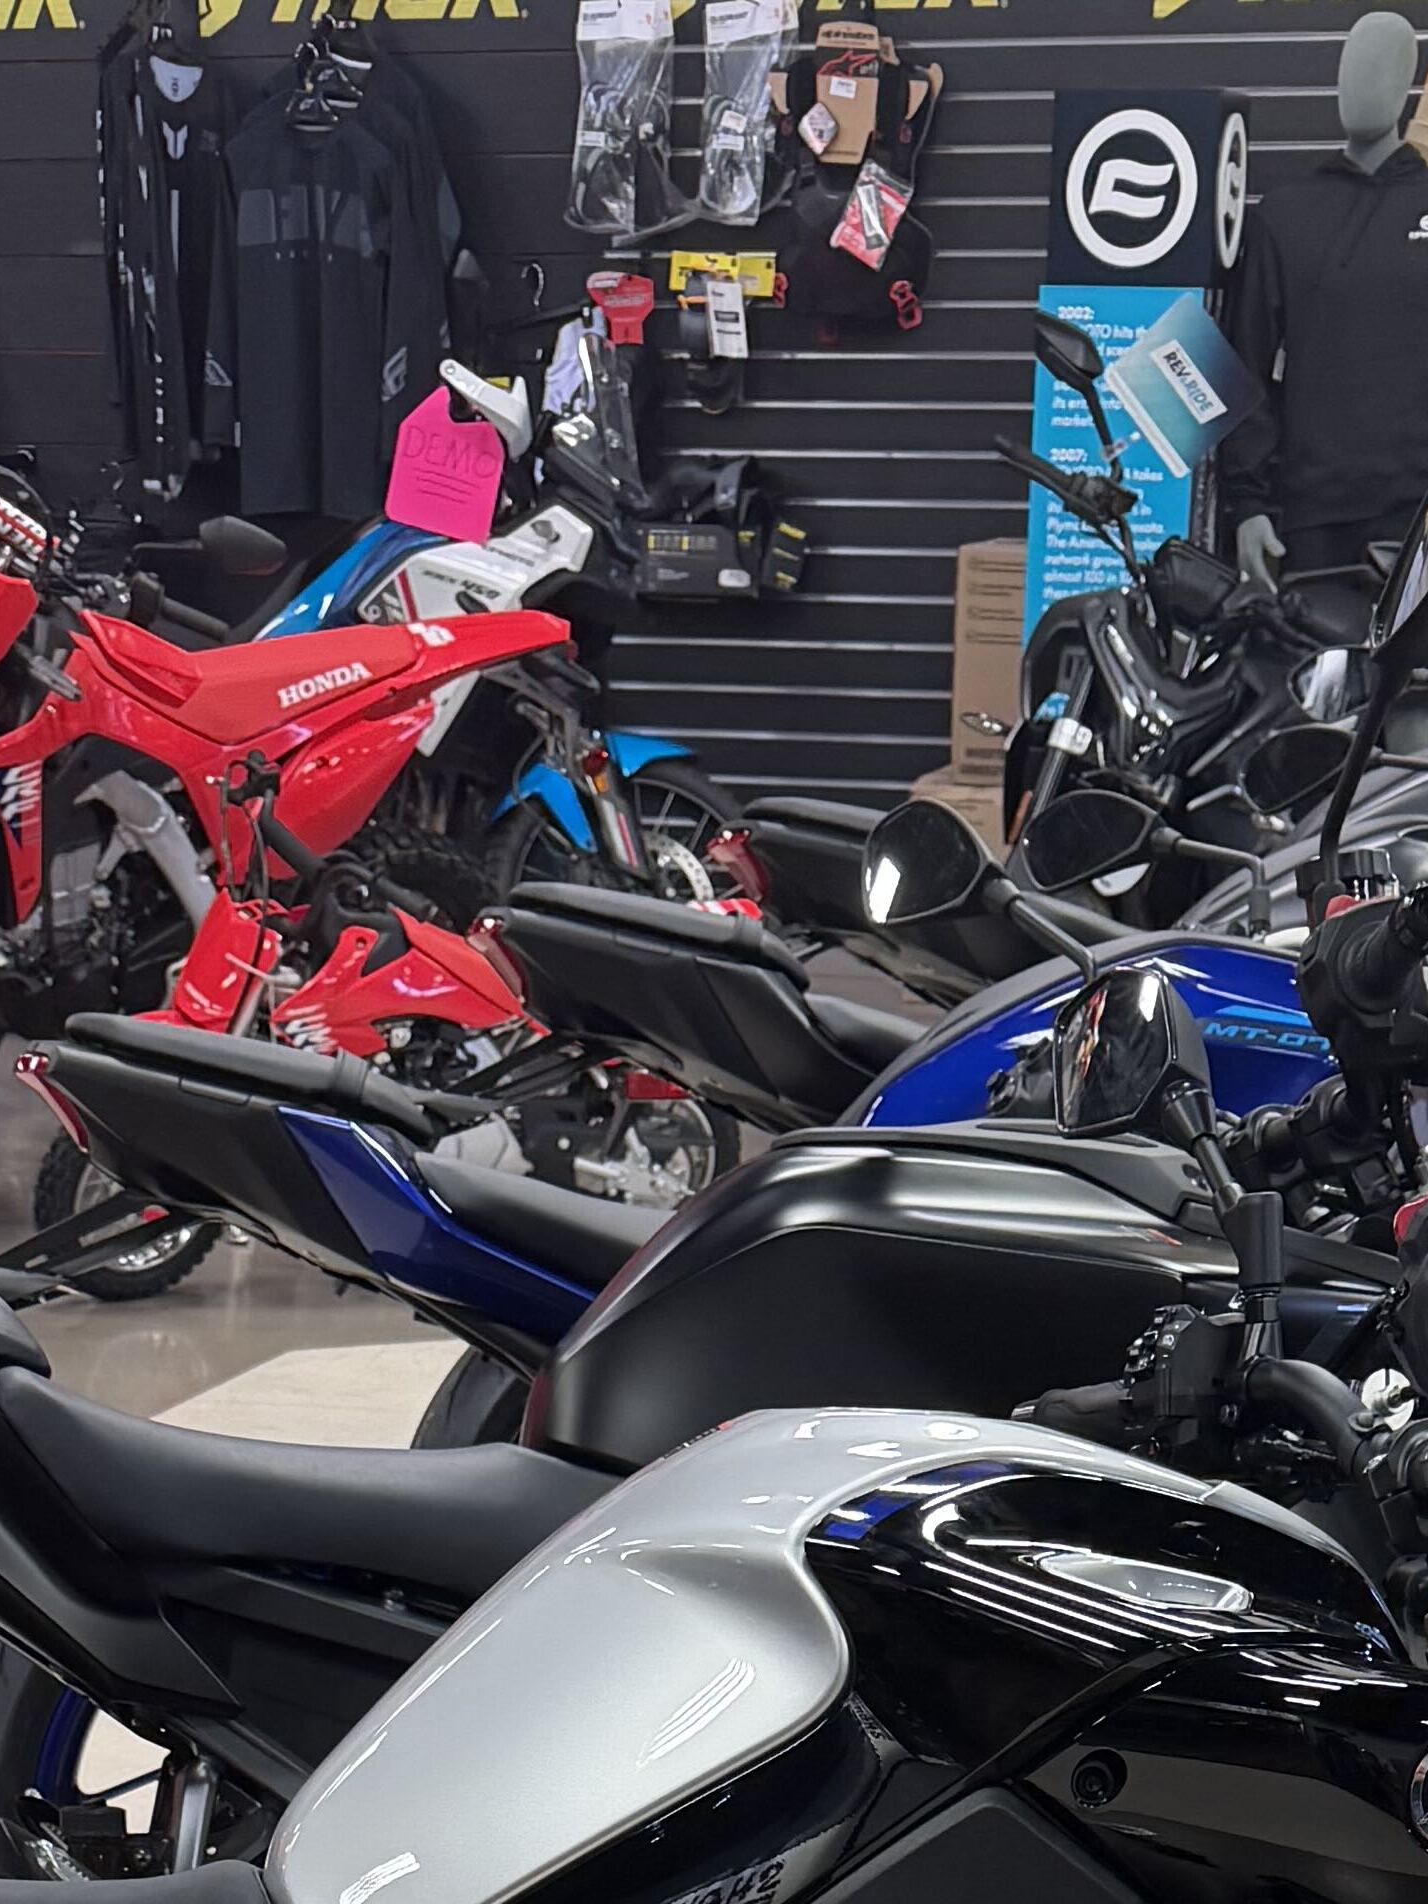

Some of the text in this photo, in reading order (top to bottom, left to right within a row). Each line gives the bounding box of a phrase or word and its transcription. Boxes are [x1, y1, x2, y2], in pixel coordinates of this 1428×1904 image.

[401, 424, 499, 480] DEMO
[277, 662, 373, 708] HONDA
[1204, 1022, 1331, 1051] MT-07
